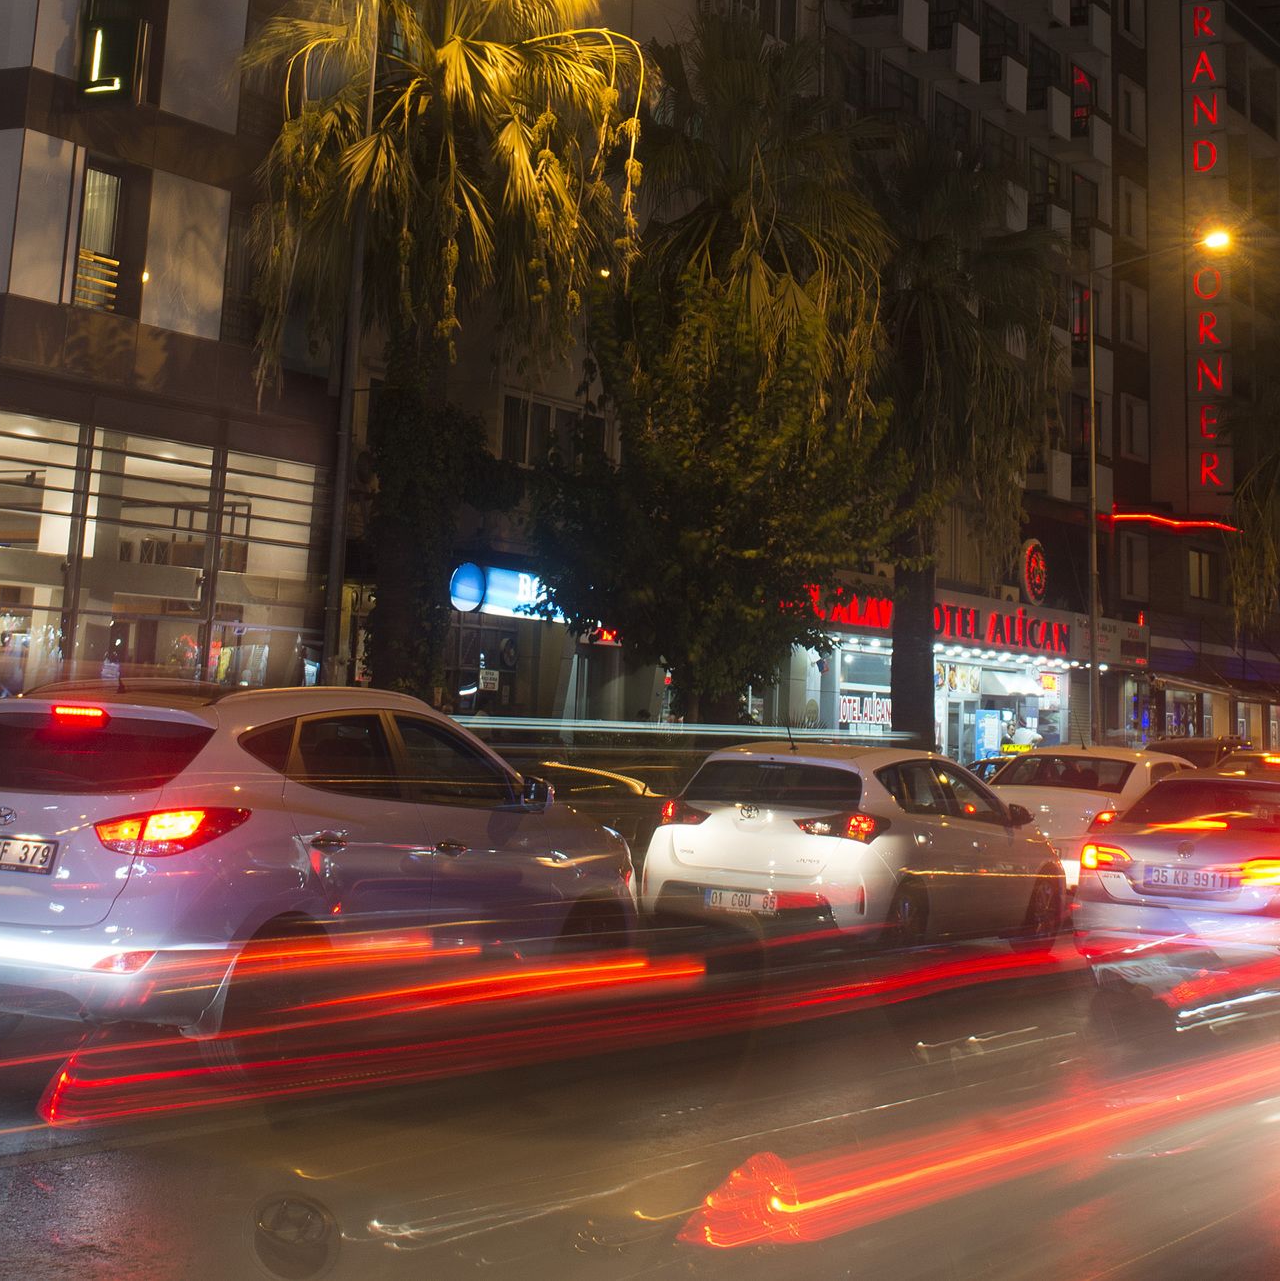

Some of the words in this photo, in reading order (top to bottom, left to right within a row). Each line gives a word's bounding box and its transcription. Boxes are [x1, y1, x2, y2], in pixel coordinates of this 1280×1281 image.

[1192, 221, 1223, 487] ORNER
[931, 602, 984, 641] OTEL
[19, 844, 52, 866] 379
[1152, 869, 1168, 884] 35
[1173, 870, 1189, 886] KB
[711, 890, 723, 906] 01
